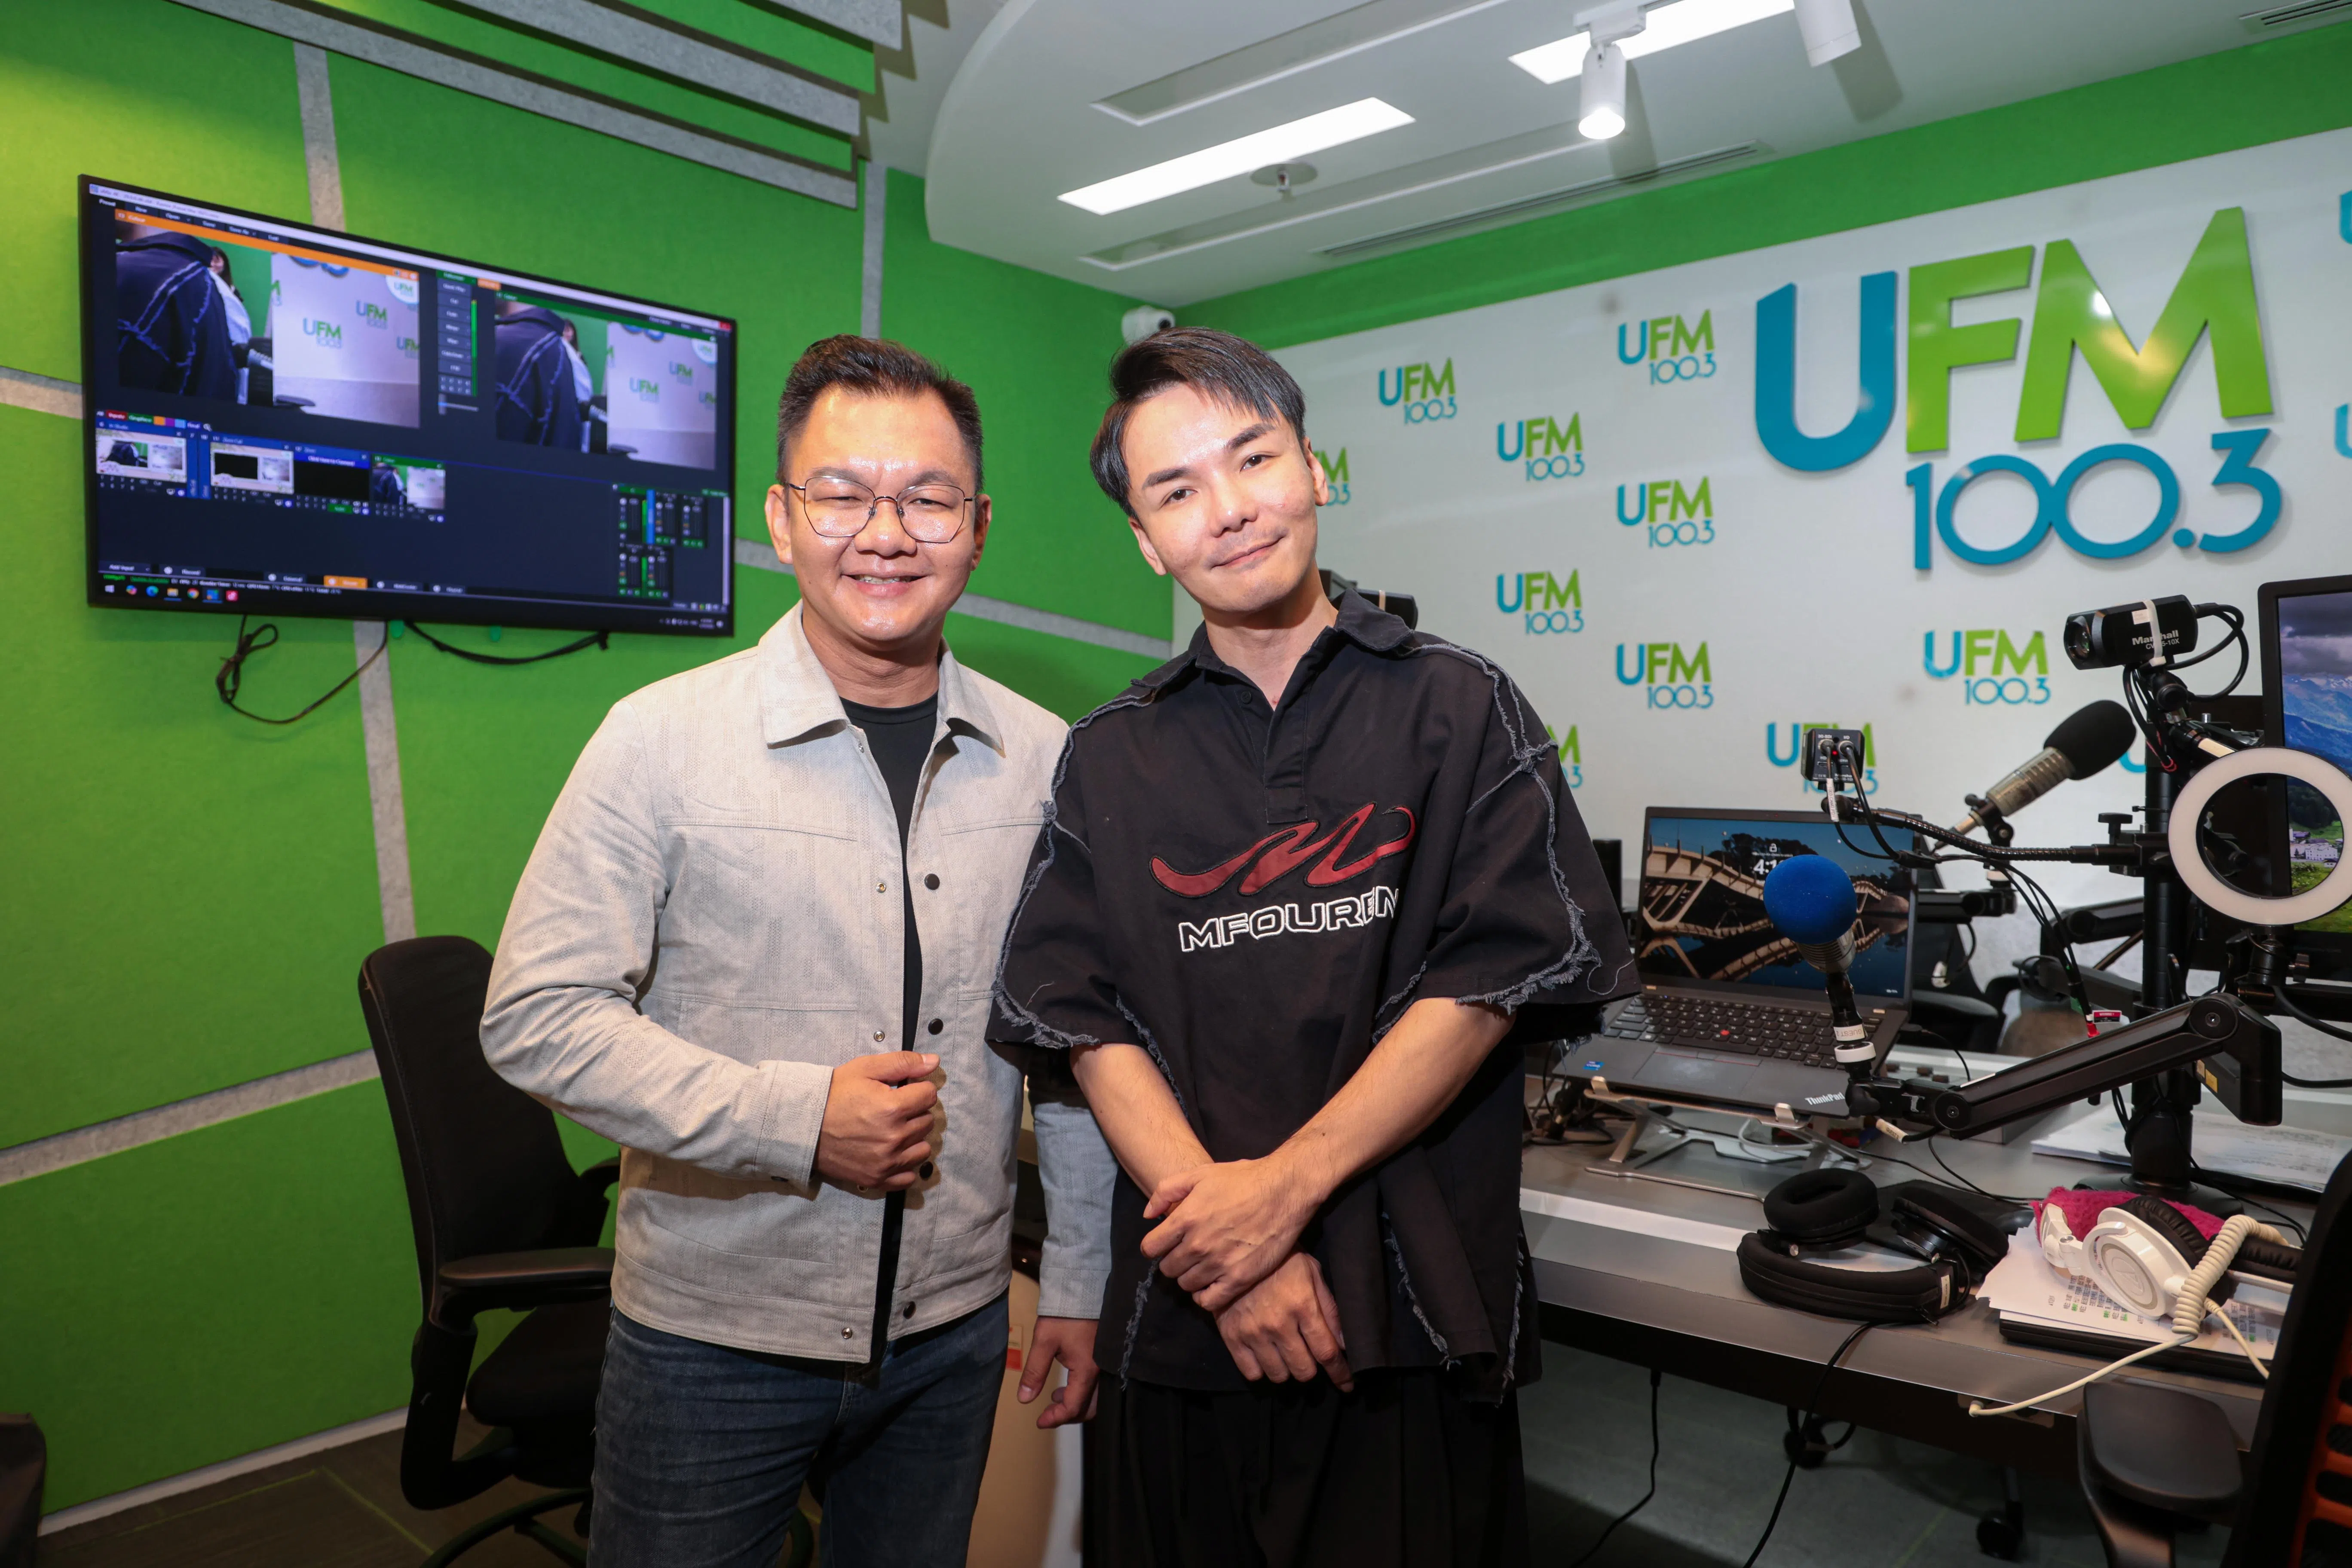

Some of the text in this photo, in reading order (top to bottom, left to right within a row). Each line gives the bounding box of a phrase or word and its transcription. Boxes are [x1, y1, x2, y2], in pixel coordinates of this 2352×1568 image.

[303, 317, 342, 340] UFM
[1617, 309, 1715, 365] UFM
[1754, 206, 2274, 472] UFM
[1378, 358, 1456, 407] UFM
[1649, 352, 1717, 385] 100.3
[1404, 395, 1458, 424] 100.3
[1497, 412, 1583, 462] UFM
[1525, 453, 1585, 482] 100.3
[1616, 476, 1714, 527] UFM
[1905, 428, 2283, 571] 100.3
[1648, 519, 1716, 548] 100.3
[1496, 569, 1582, 614] UFM
[1525, 609, 1584, 635] 100.3
[2132, 630, 2179, 646] Marhall
[2146, 638, 2180, 649] CV5-10X
[1616, 642, 1712, 686] UFM
[1923, 629, 2049, 679] UFM
[1648, 684, 1714, 709] 100.3
[1965, 676, 2051, 706] 100.3
[1753, 859, 1784, 875] 4:1
[1841, 1029, 1862, 1037] GUEST
[1805, 1092, 1845, 1106] ThinkPad
